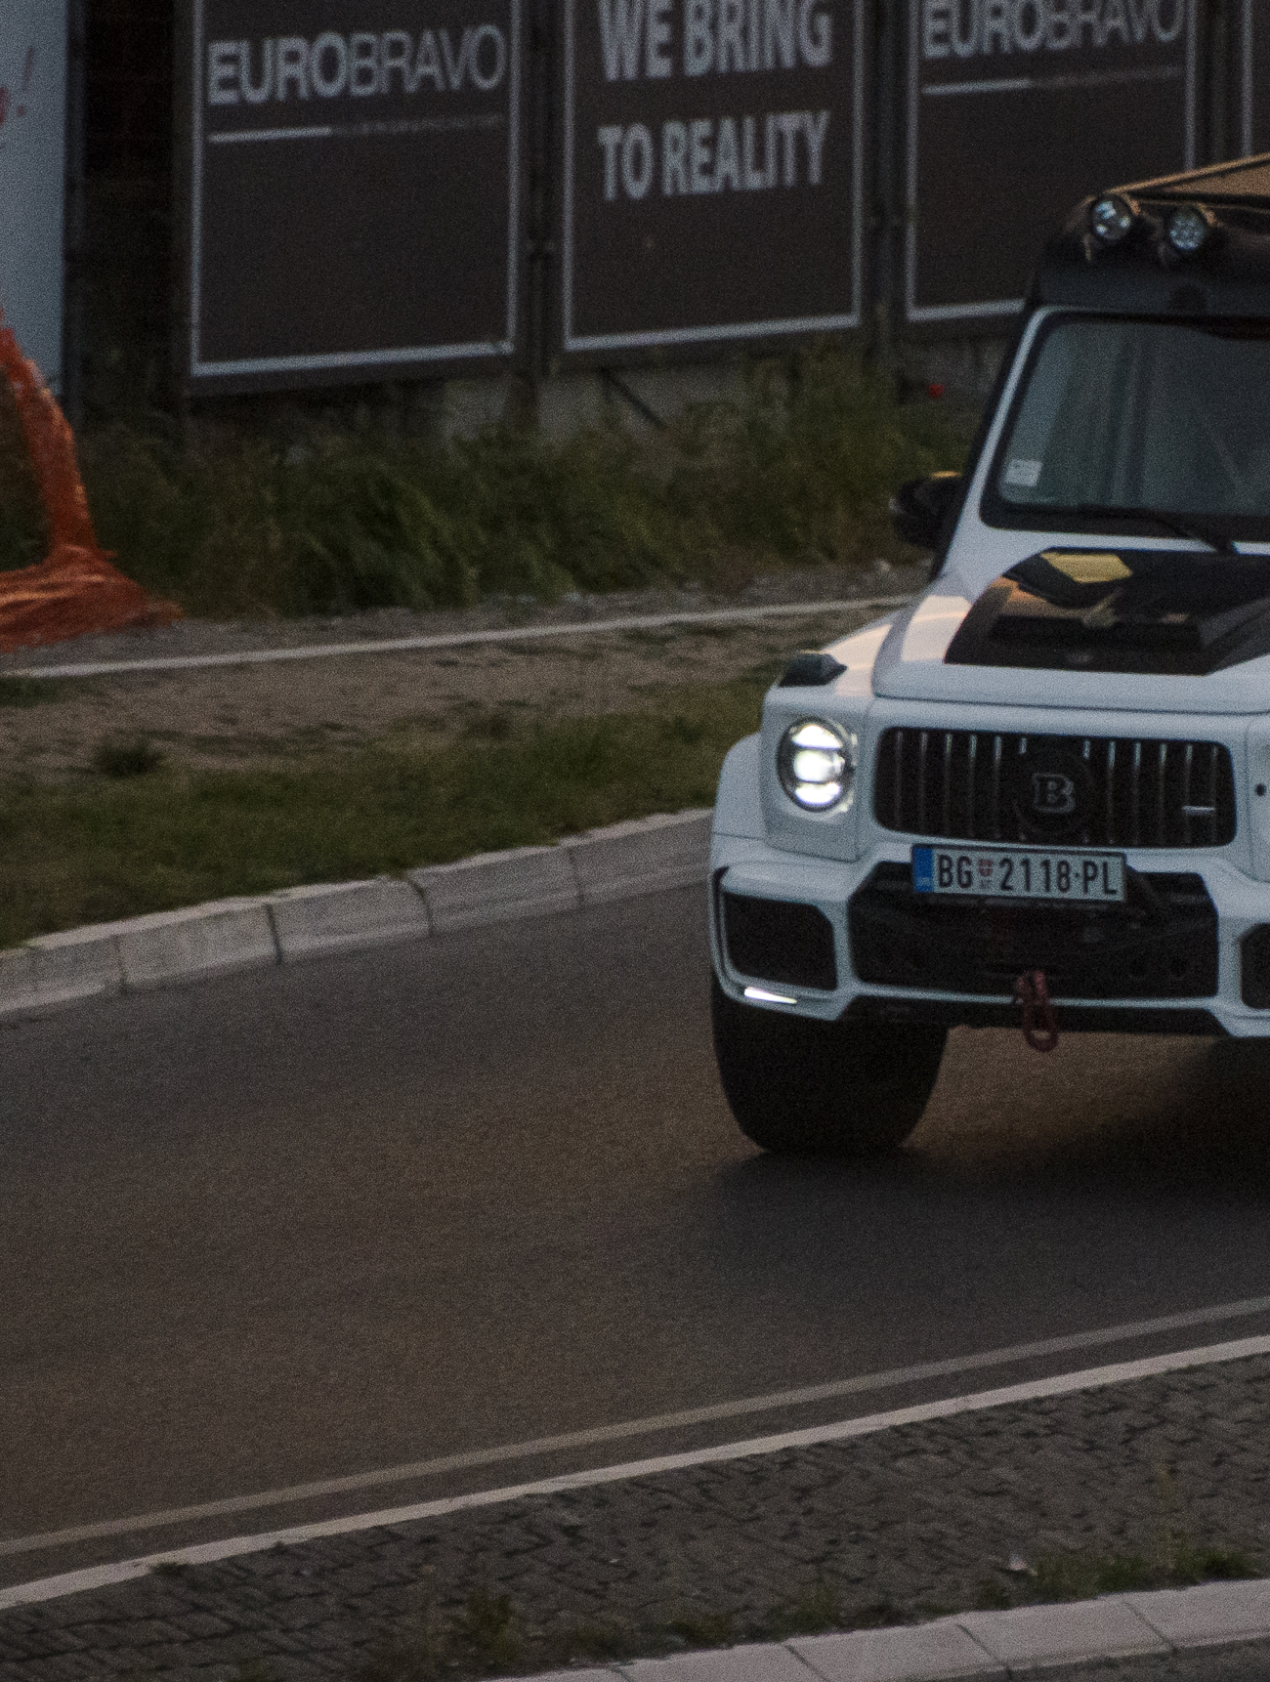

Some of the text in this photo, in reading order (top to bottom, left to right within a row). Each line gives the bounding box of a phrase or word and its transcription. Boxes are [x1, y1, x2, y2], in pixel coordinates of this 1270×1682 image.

[207, 24, 506, 105] EUROBRAVO
[600, 0, 832, 81] WE BRING
[922, 0, 1186, 58] EUROBRAVO
[598, 110, 831, 200] TO REALITY
[938, 854, 973, 889] BG
